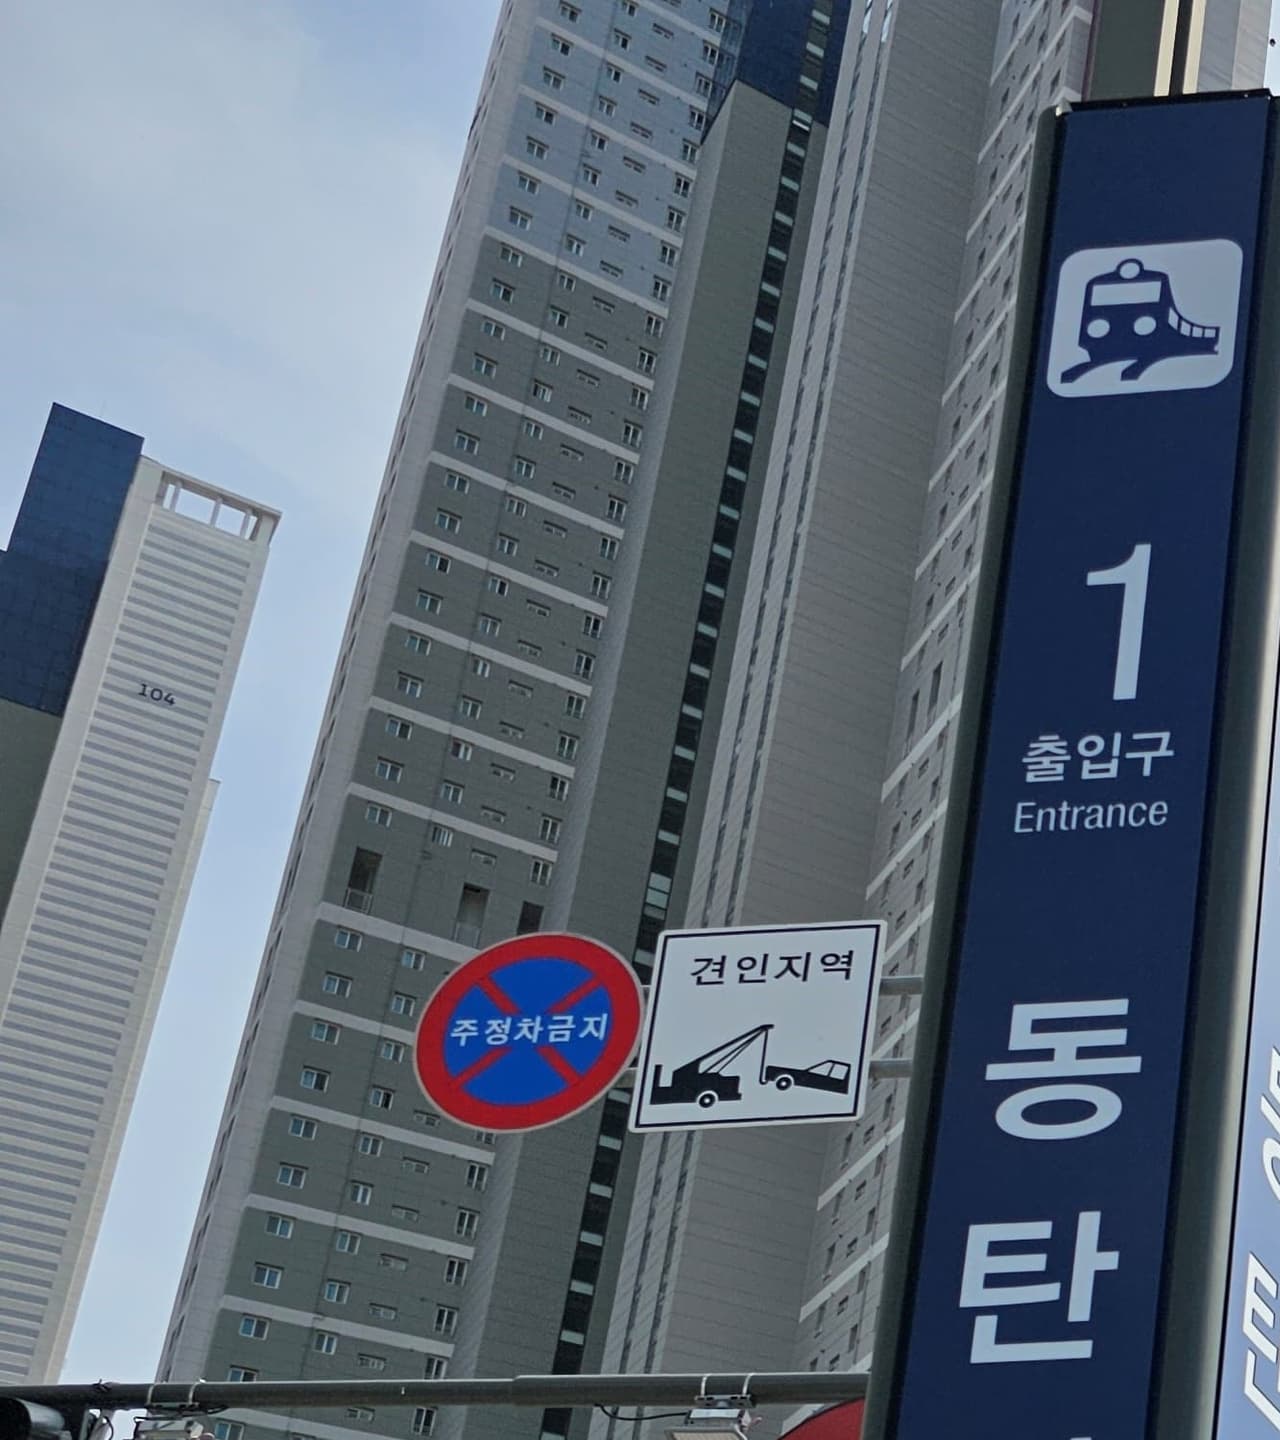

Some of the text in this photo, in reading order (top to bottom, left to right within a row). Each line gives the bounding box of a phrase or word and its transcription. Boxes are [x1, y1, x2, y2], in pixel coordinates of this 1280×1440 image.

[1086, 543, 1152, 701] 1
[138, 683, 176, 706] 104
[1021, 731, 1175, 784] 출입구
[1013, 800, 1169, 834] Entrance
[690, 949, 856, 987] 견인지역
[449, 1012, 608, 1048] 주정차금지
